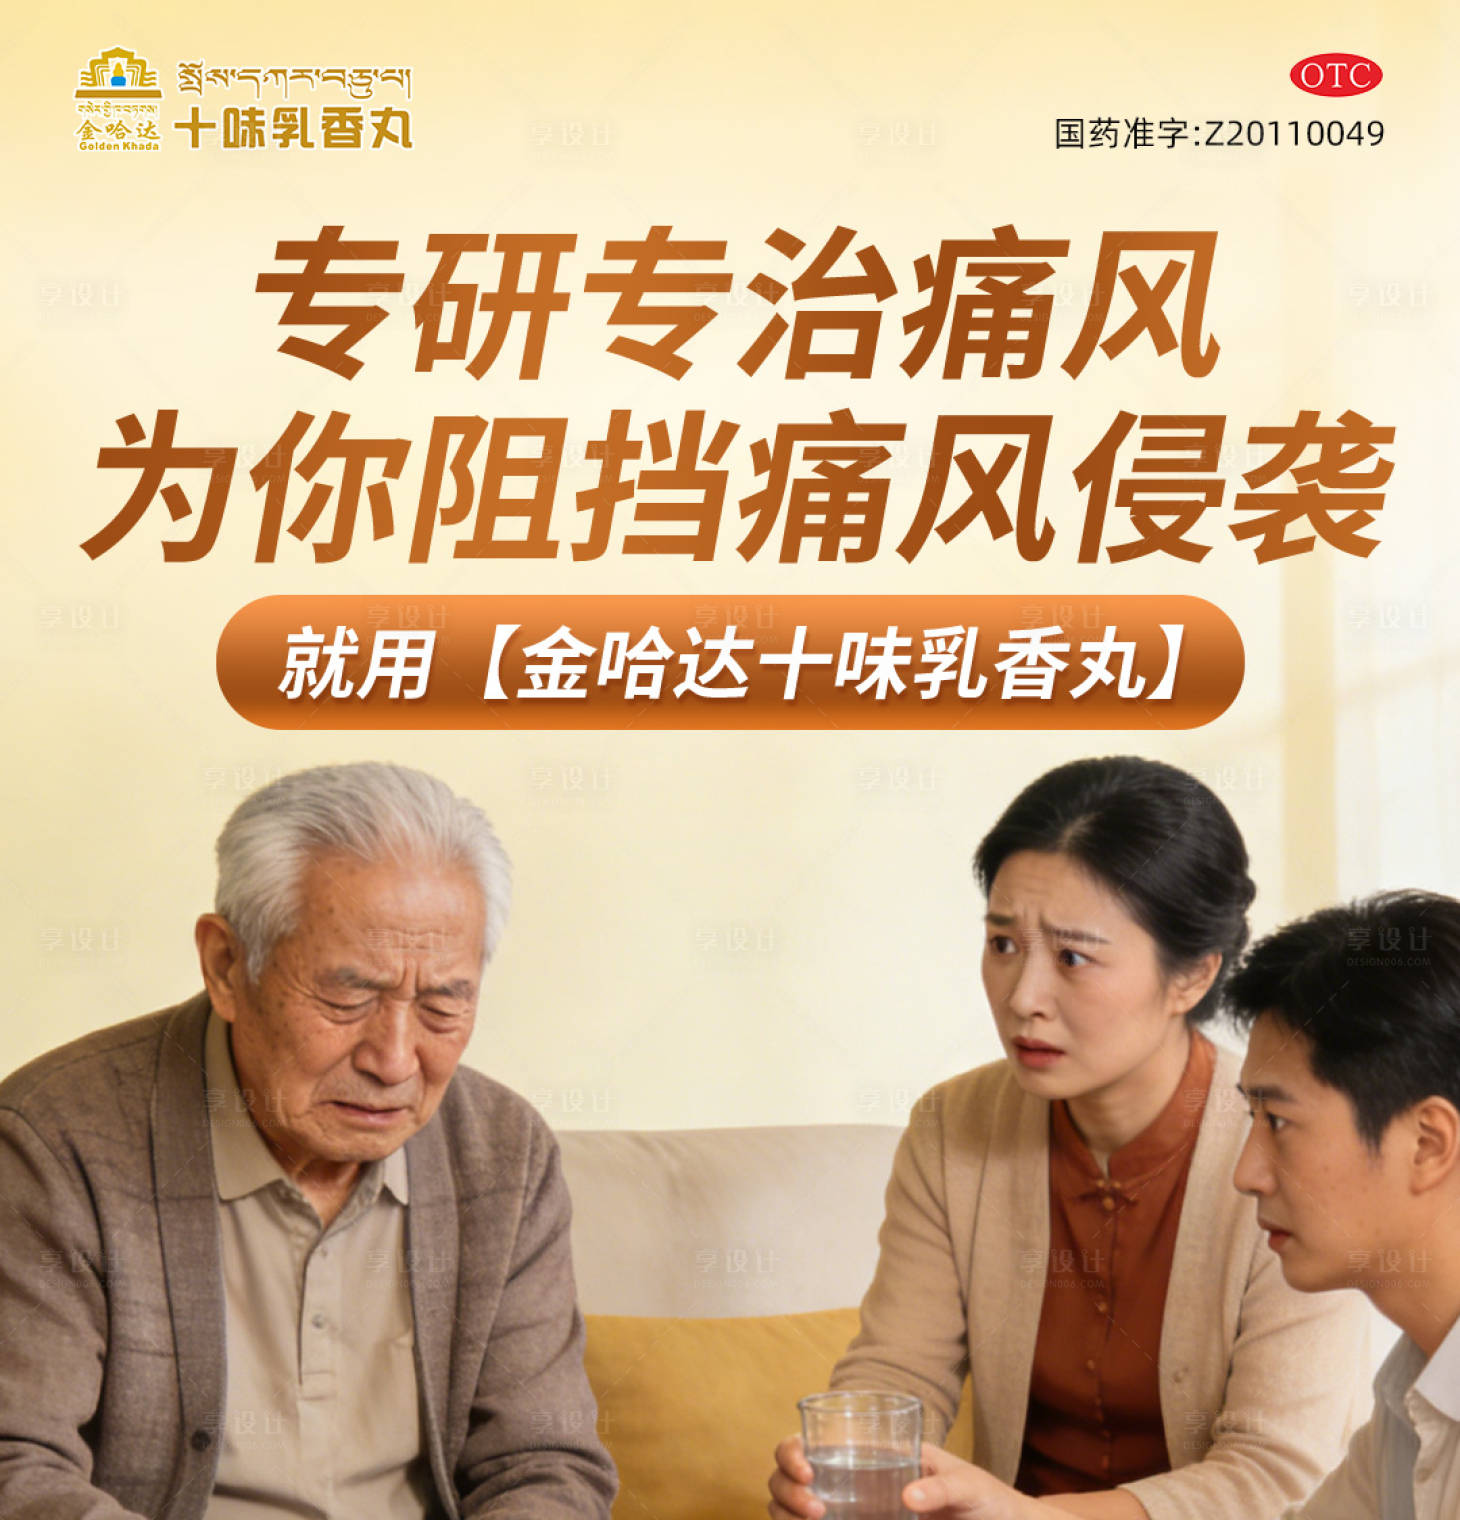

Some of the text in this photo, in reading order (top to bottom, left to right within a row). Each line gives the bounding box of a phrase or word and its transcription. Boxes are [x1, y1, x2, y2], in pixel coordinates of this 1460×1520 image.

[1299, 61, 1373, 89] OTC
[76, 119, 160, 140] 金哈达
[79, 141, 159, 151] Golden Khada
[174, 107, 413, 149] 十味乳香丸
[1056, 117, 1384, 150] 国药准字:Z20110049
[255, 224, 1221, 381] 专研专治痛风
[79, 408, 1396, 565] 为你阻挡痛风侵袭
[278, 626, 1184, 704] 就用【金哈达十味乳香丸】
